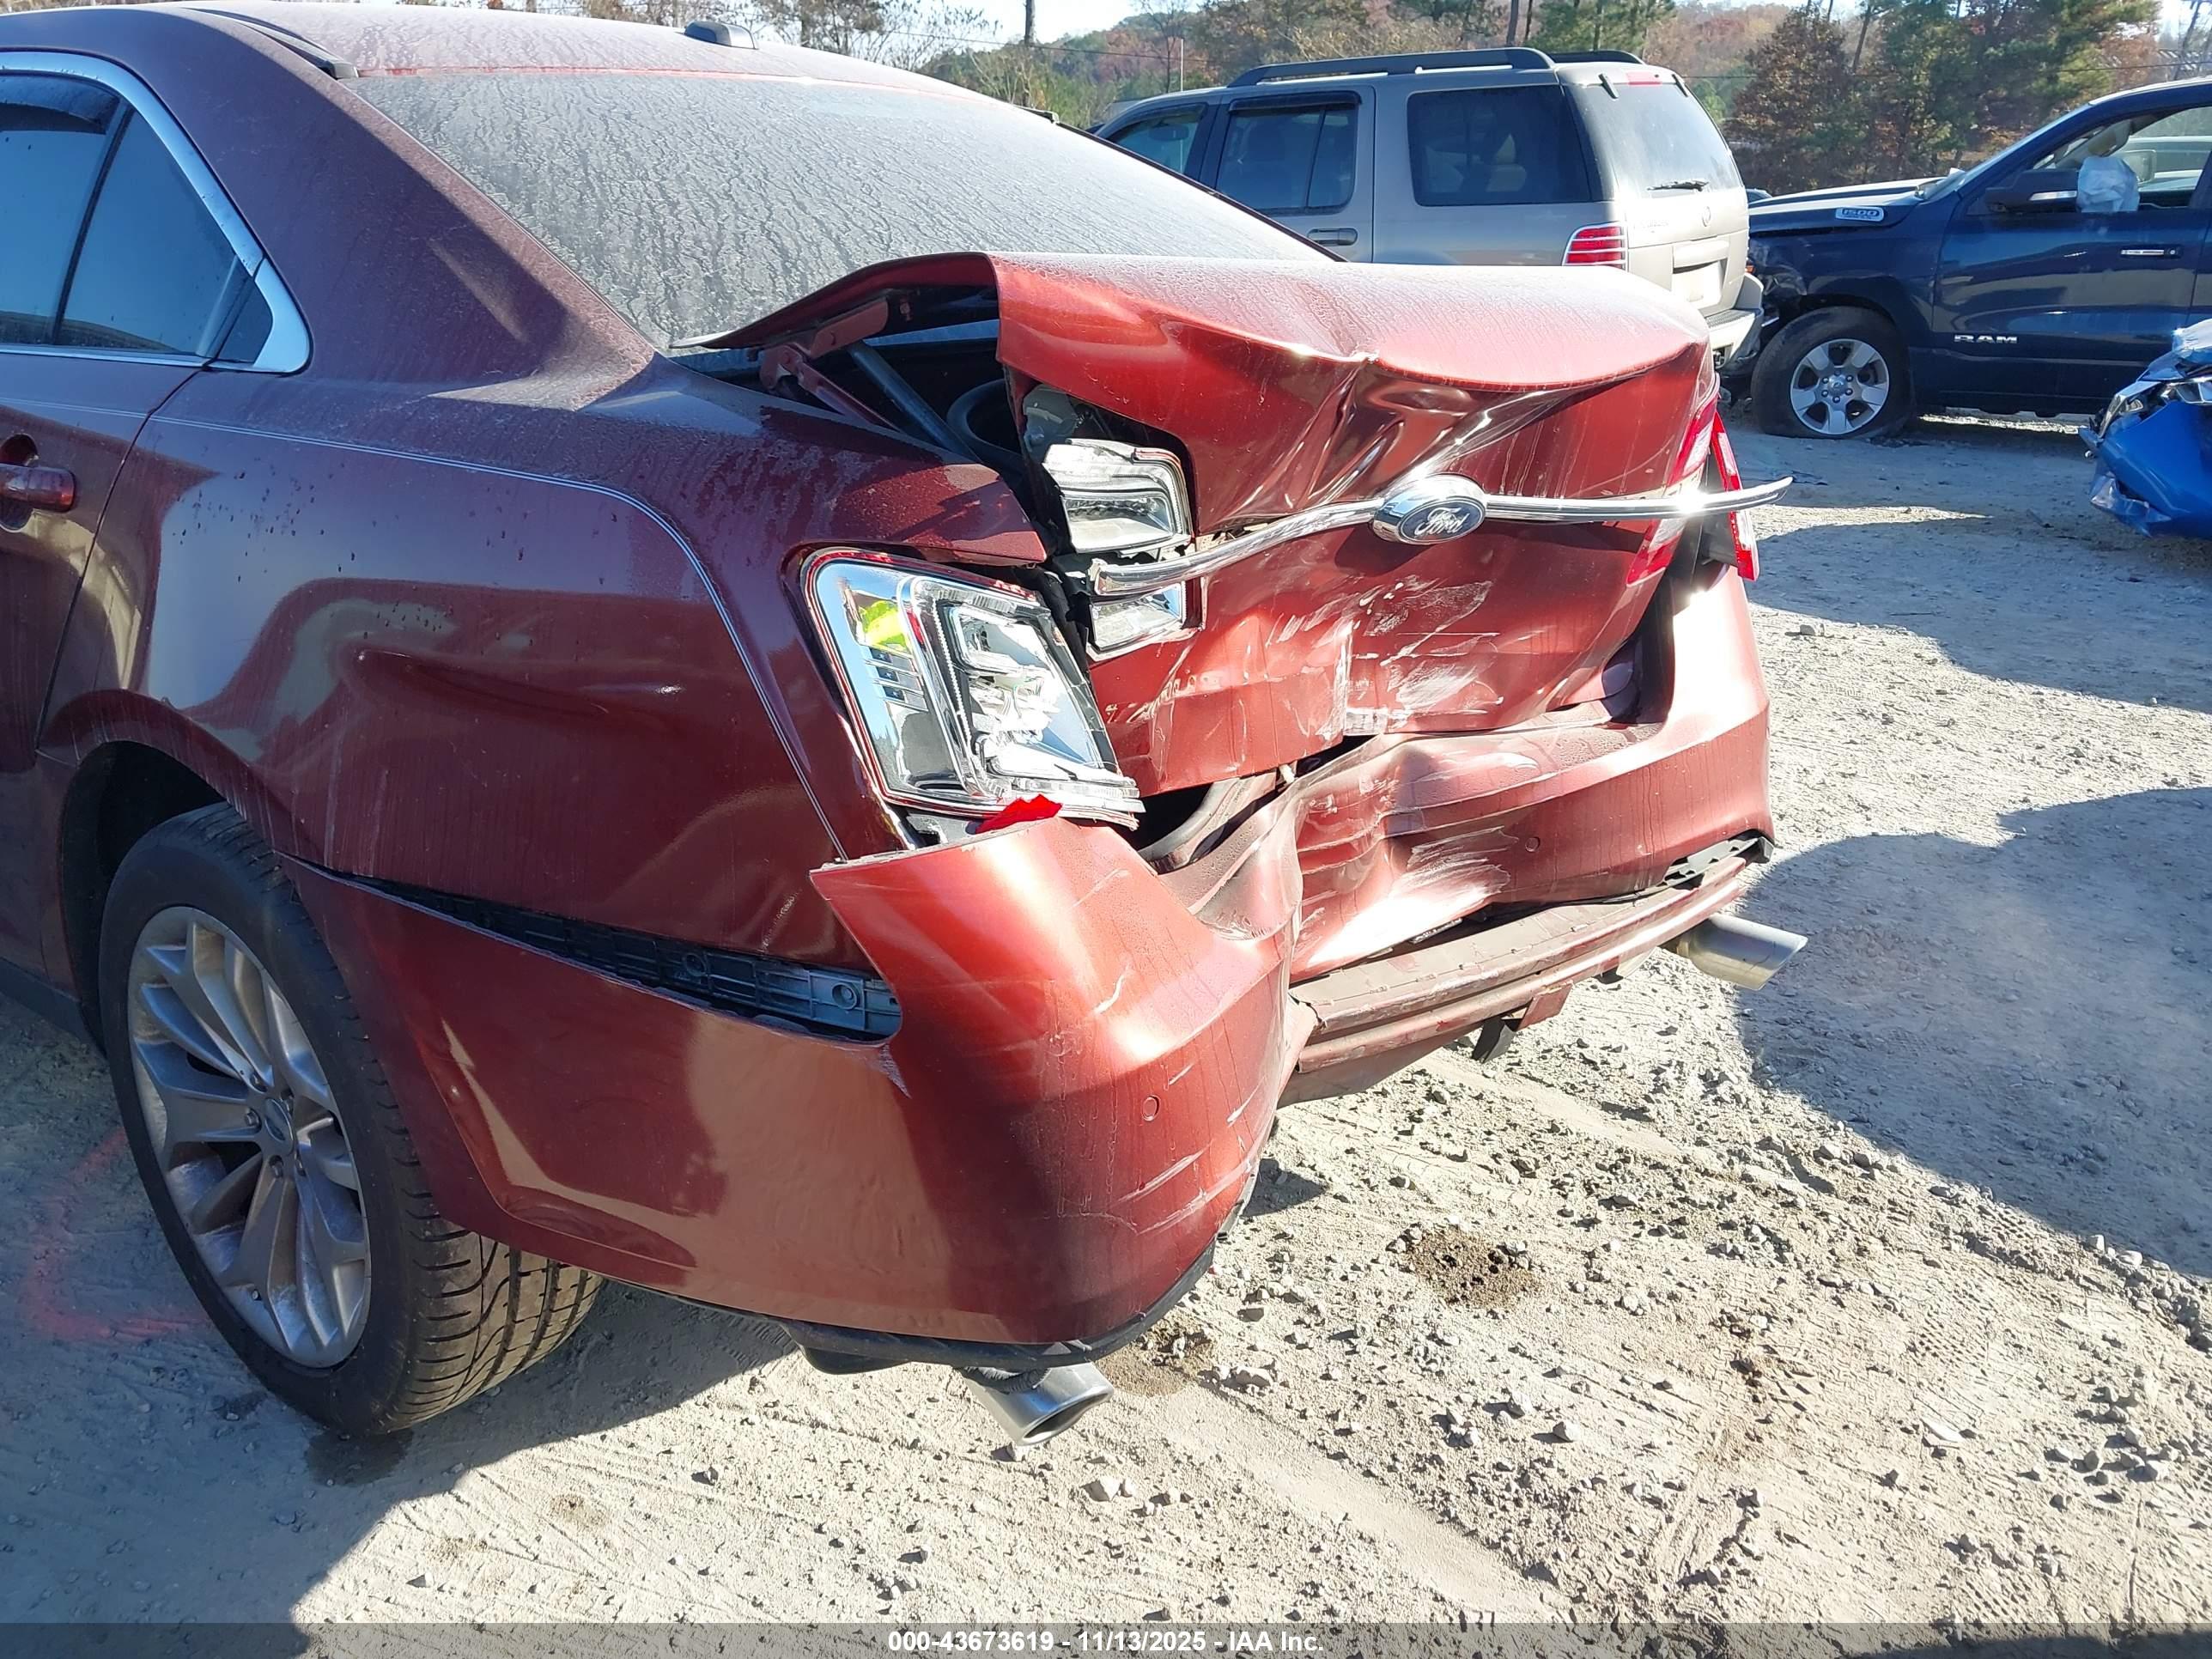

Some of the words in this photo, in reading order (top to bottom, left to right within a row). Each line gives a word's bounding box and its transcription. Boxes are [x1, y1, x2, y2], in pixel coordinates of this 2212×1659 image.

[1842, 208, 1880, 216] 1500
[1954, 334, 2018, 343] RAM
[1414, 507, 1471, 536] Ford
